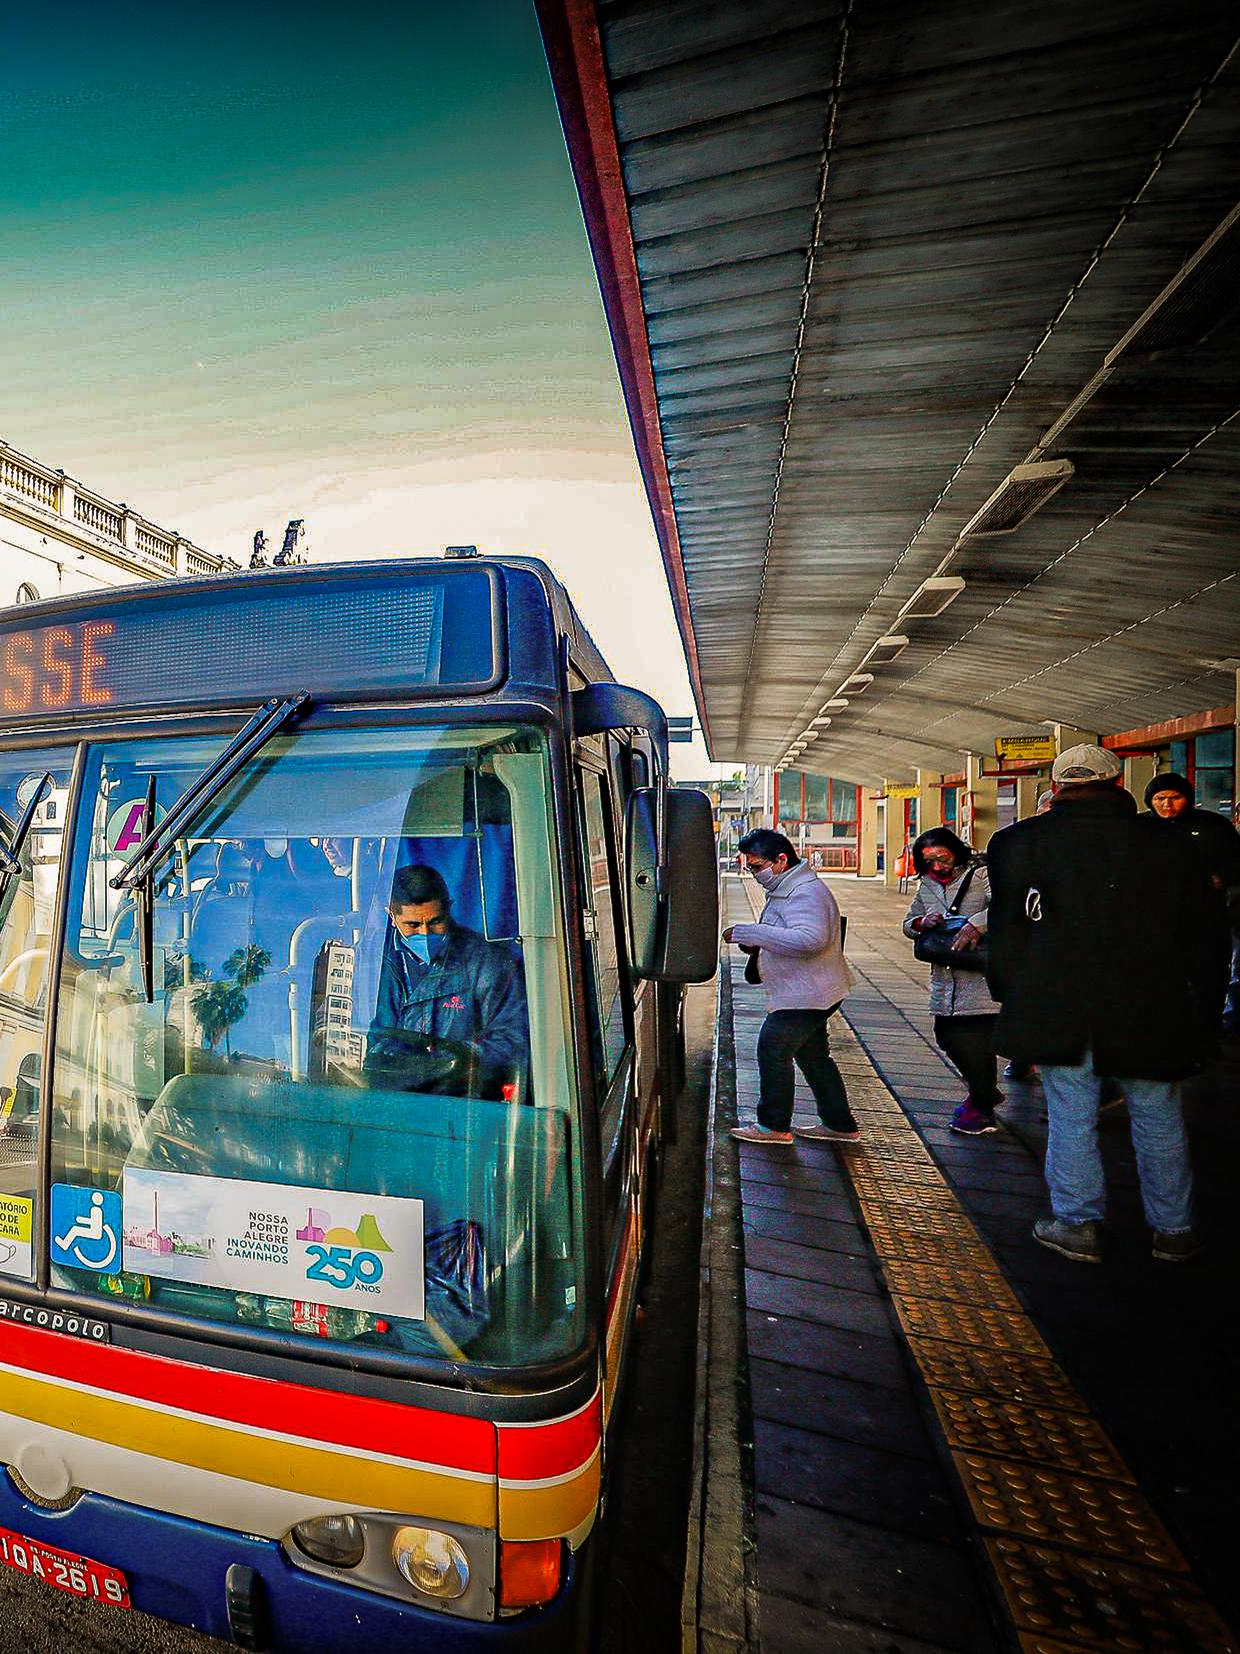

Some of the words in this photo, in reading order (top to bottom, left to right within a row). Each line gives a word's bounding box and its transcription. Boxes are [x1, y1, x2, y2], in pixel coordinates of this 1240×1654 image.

[8, 1214, 19, 1224] DE
[248, 1211, 289, 1225] NOSSA
[249, 1222, 289, 1235] PORTO
[244, 1231, 289, 1245] ALEGRE
[227, 1237, 289, 1255] INOVANDO
[226, 1247, 289, 1265] CAMINHOS
[305, 1244, 384, 1289] 250
[354, 1283, 382, 1295] ANOS
